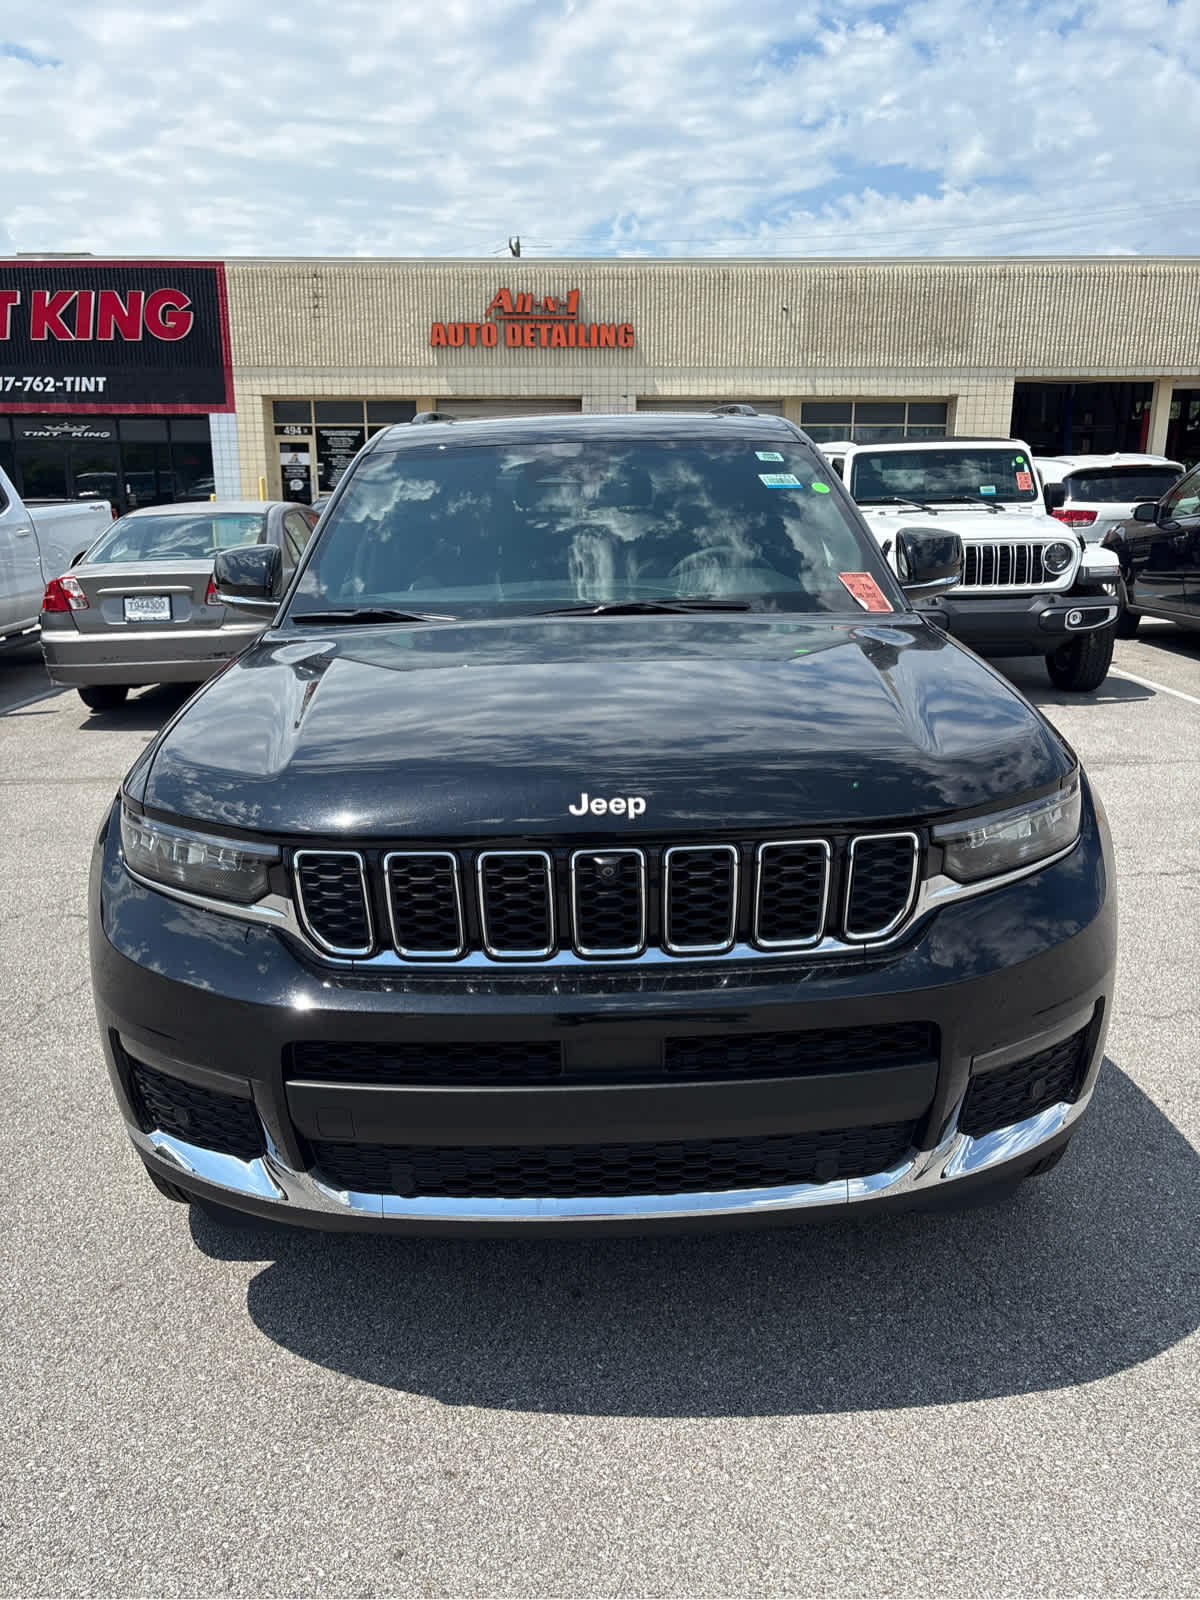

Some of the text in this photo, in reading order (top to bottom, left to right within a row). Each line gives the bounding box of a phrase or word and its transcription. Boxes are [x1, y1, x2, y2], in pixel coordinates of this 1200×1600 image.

[30, 288, 194, 341] KING
[430, 322, 634, 348] AUTO DETAILING
[283, 426, 302, 435] 494
[568, 792, 647, 819] Jeep
